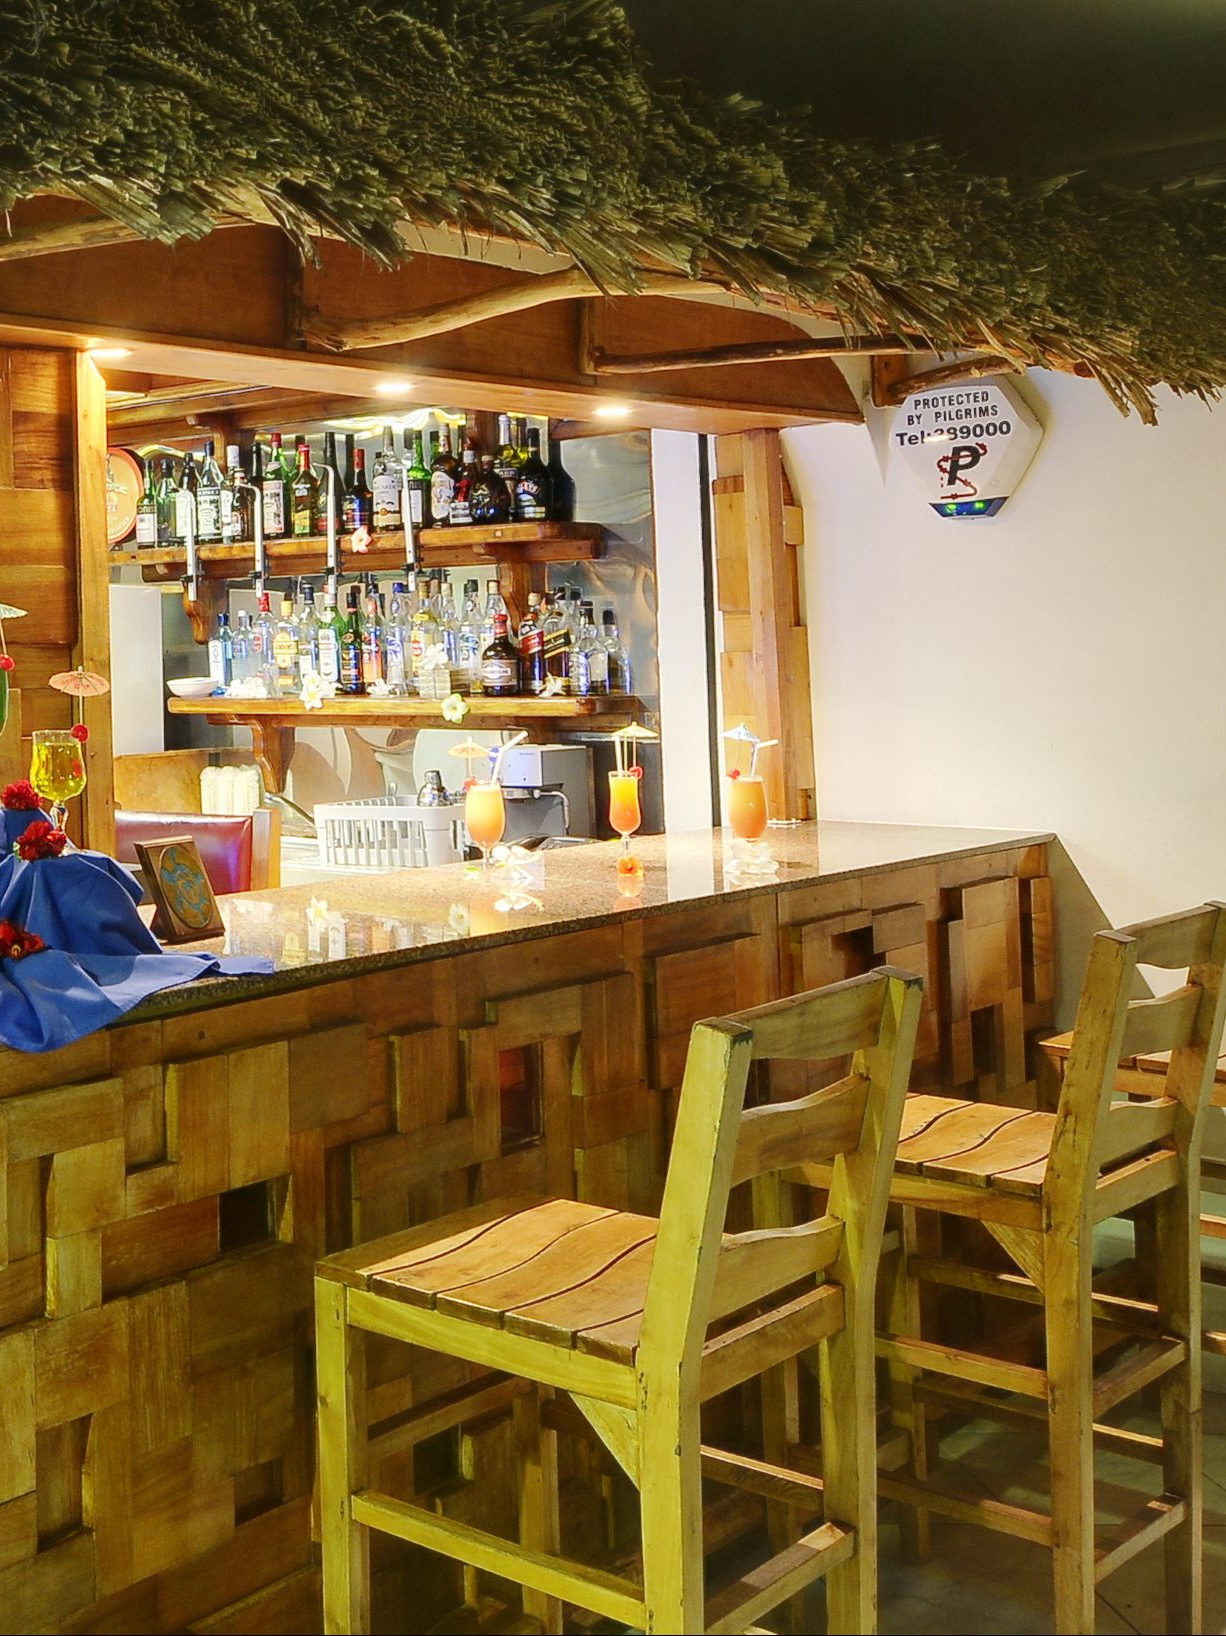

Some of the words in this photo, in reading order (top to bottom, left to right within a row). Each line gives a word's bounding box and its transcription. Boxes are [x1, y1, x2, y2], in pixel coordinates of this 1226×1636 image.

[914, 391, 989, 410] PROTECTED
[907, 413, 922, 426] BY
[934, 404, 998, 423] PILGRIMS
